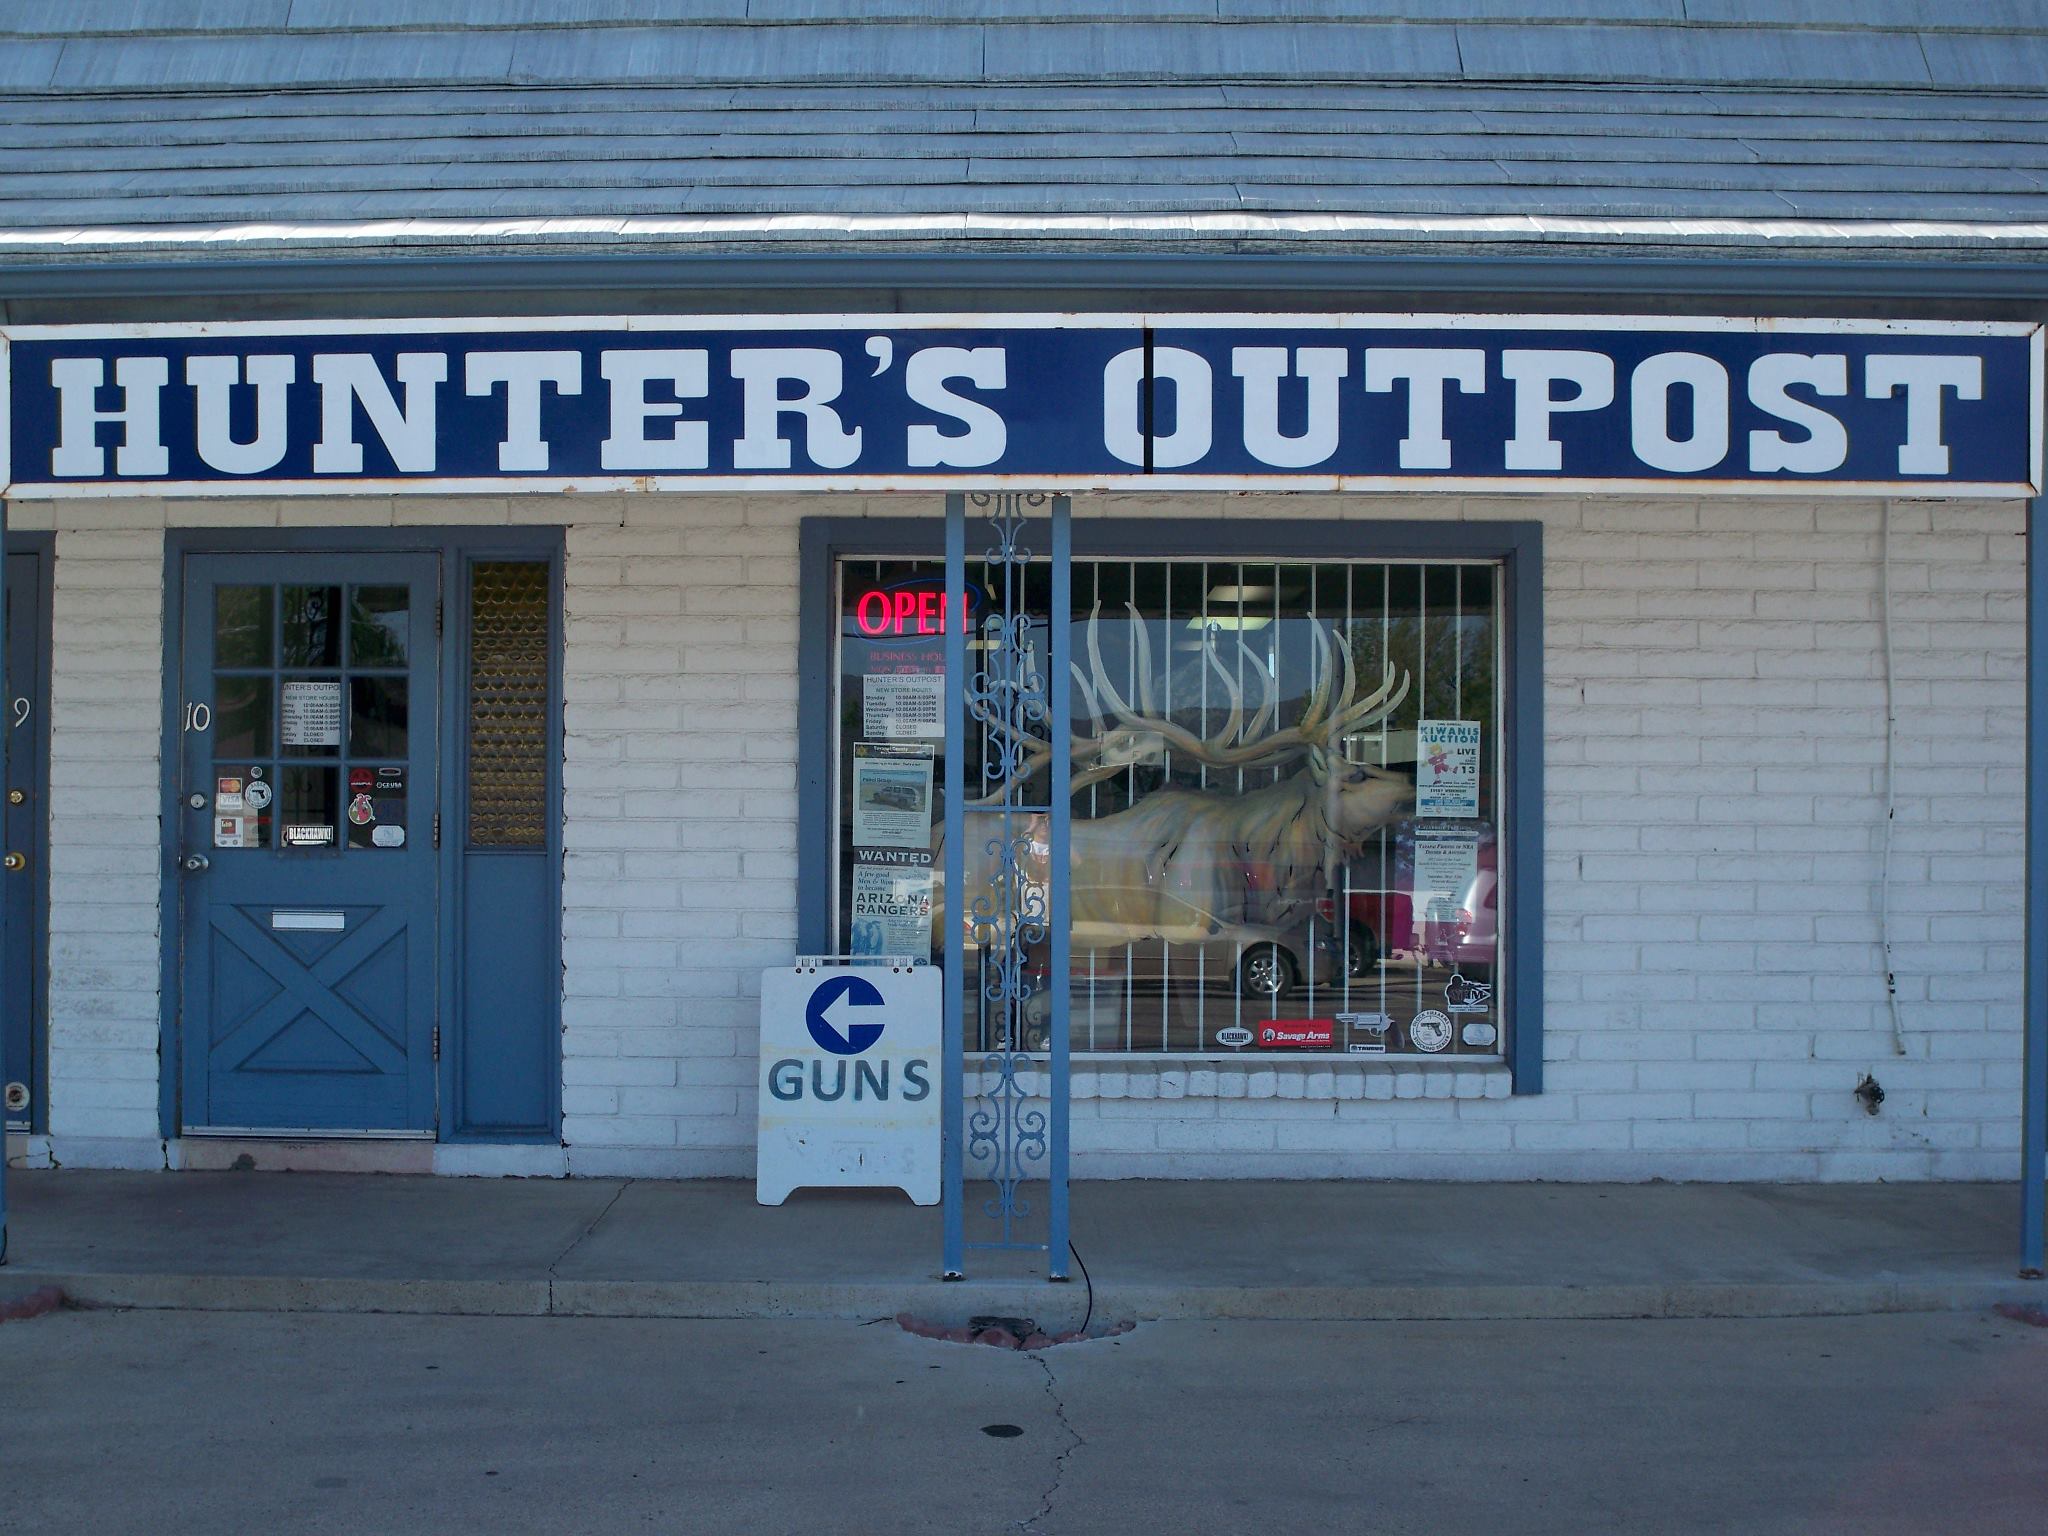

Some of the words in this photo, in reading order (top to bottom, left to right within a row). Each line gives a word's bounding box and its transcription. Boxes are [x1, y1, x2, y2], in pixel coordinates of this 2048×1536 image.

[51, 335, 1007, 476] HUNTER'S
[1103, 346, 1983, 474] OUTPOST
[14, 698, 31, 728] 9
[184, 702, 211, 732] 10
[1420, 726, 1479, 736] KIWANIS
[1421, 735, 1478, 743] AUCTION
[1461, 766, 1476, 774] 13
[288, 827, 331, 840] BLACKHAWK!
[858, 850, 932, 864] WANTED
[856, 893, 929, 906] ARIZONA
[856, 904, 929, 916] RANGERS
[1276, 1031, 1305, 1041] Savage
[1306, 1031, 1330, 1040] Arms
[768, 1058, 931, 1102] GUNS
